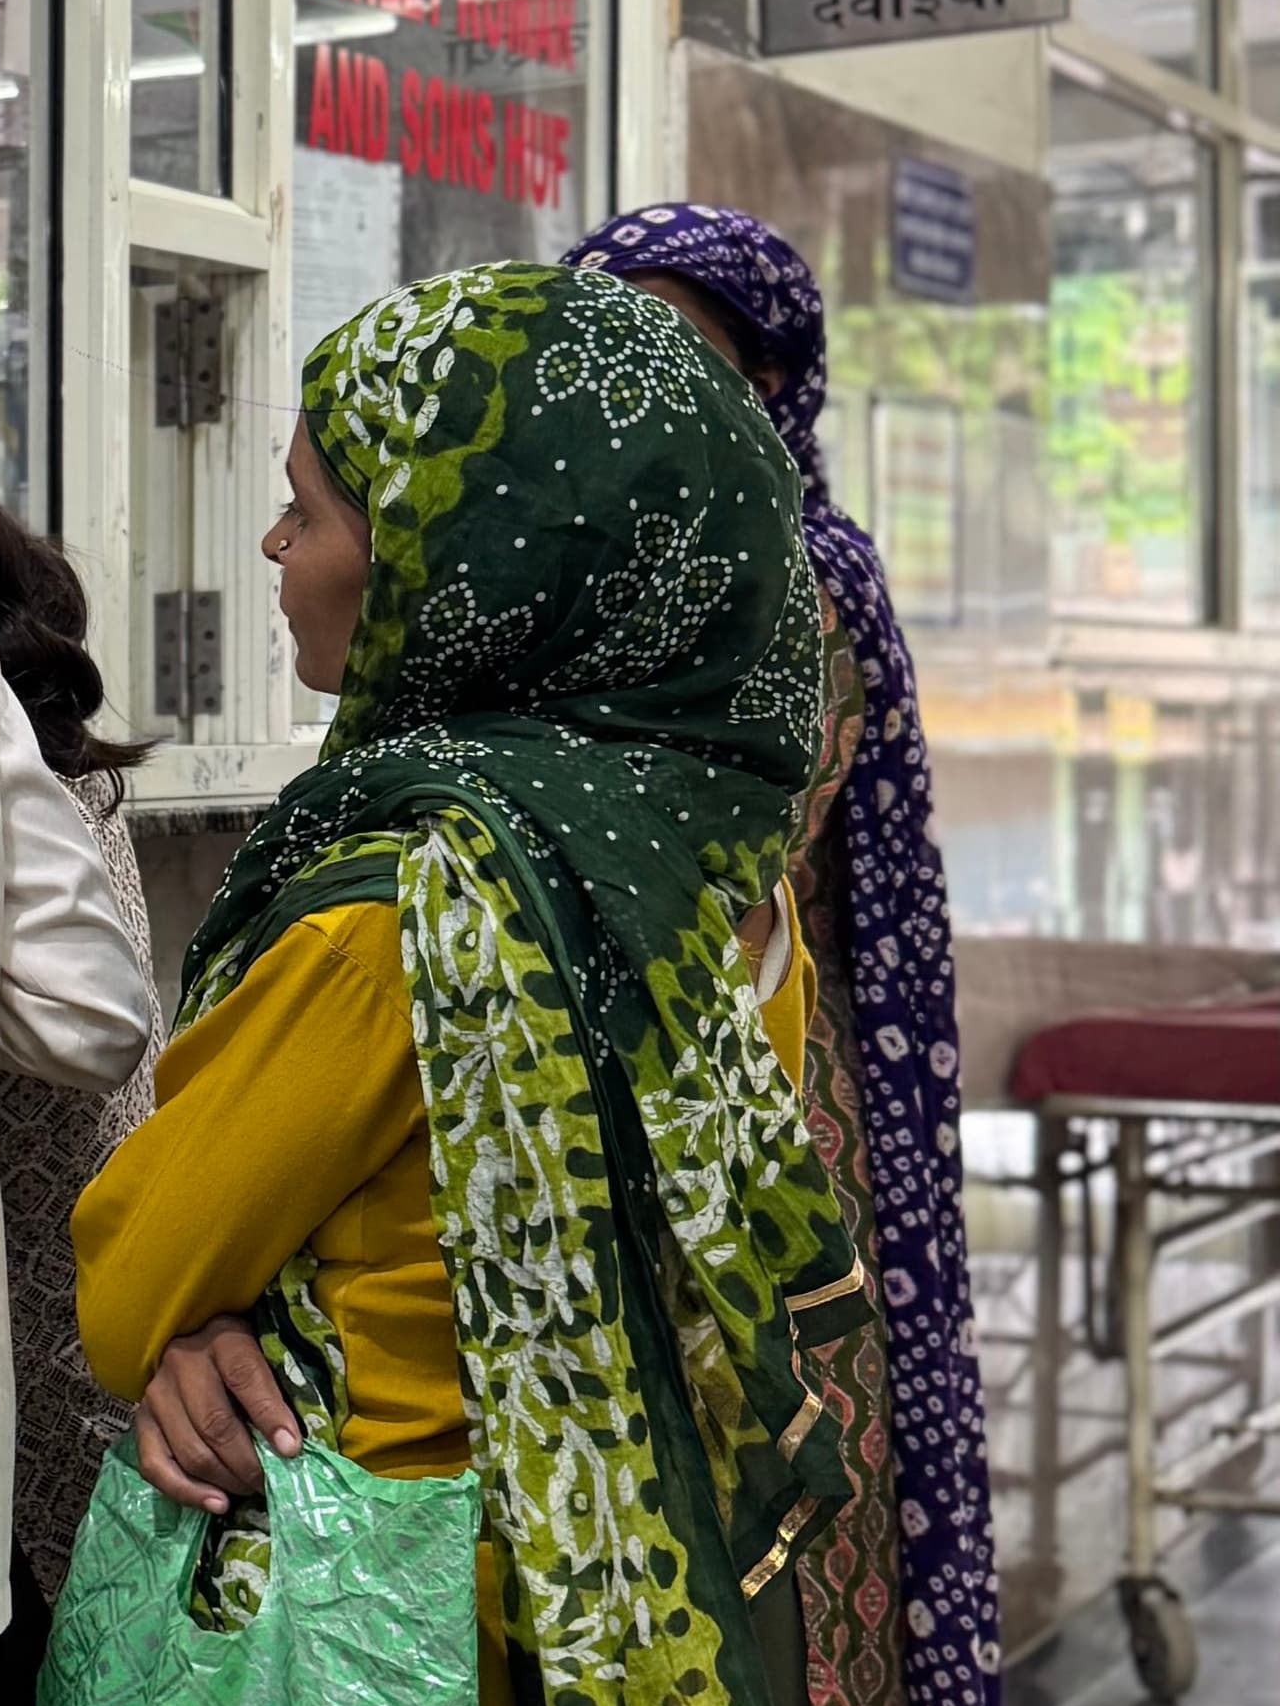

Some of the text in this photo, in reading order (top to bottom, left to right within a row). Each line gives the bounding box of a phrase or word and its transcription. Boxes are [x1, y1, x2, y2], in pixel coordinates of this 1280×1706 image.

[308, 43, 571, 208] AND SONS HUF
